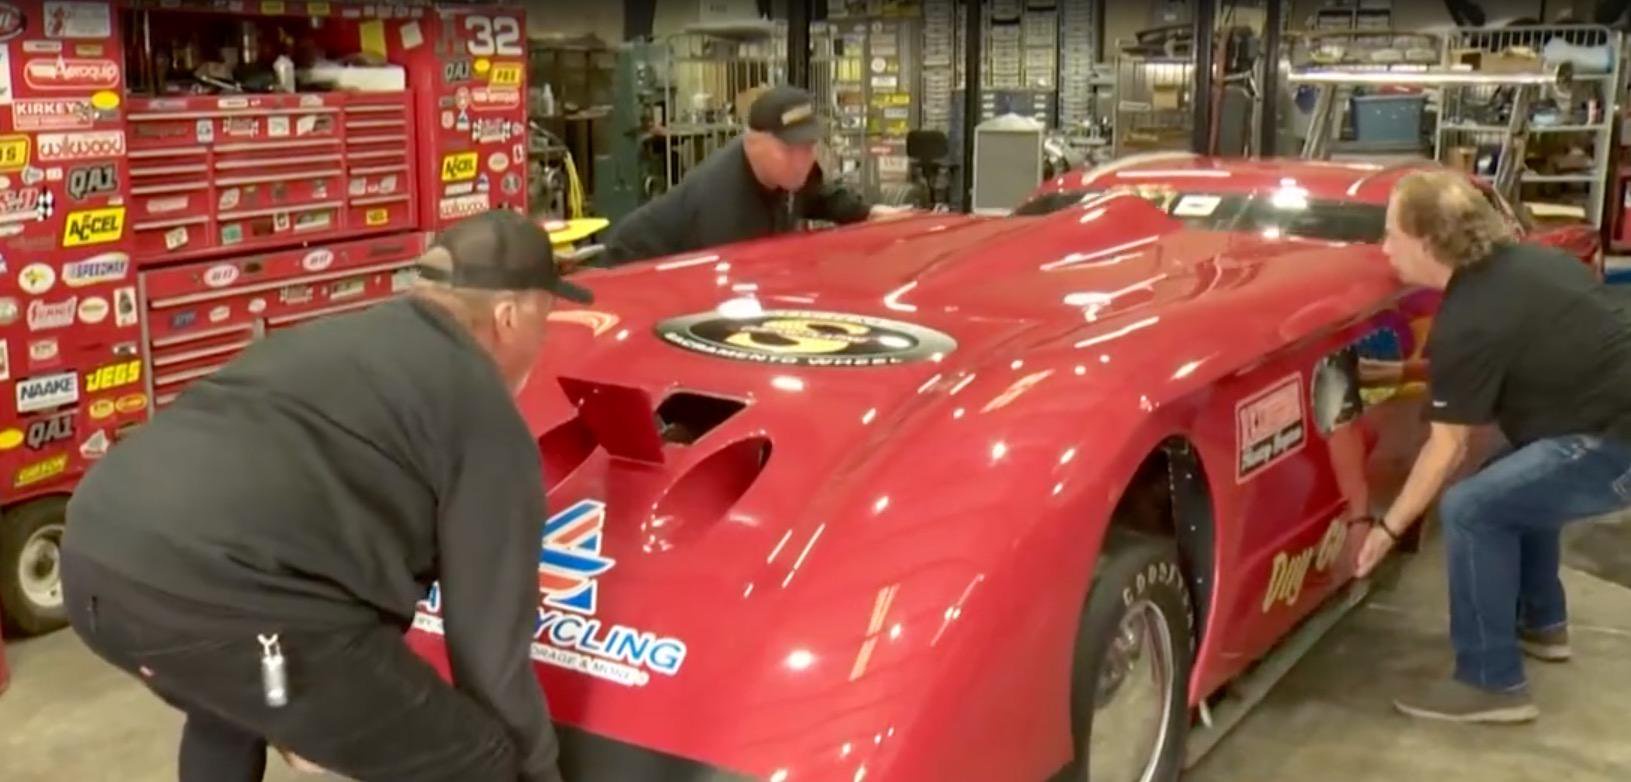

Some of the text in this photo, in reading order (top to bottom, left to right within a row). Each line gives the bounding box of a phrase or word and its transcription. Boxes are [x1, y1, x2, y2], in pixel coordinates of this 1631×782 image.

[464, 16, 523, 56] 32
[16, 103, 75, 115] KIRKEY
[69, 165, 118, 200] QA1
[69, 214, 120, 241] ACCEL
[808, 355, 904, 366] WHEEL
[20, 376, 73, 401] NAAKE
[86, 360, 141, 392] JEGS
[27, 416, 73, 449] QA1
